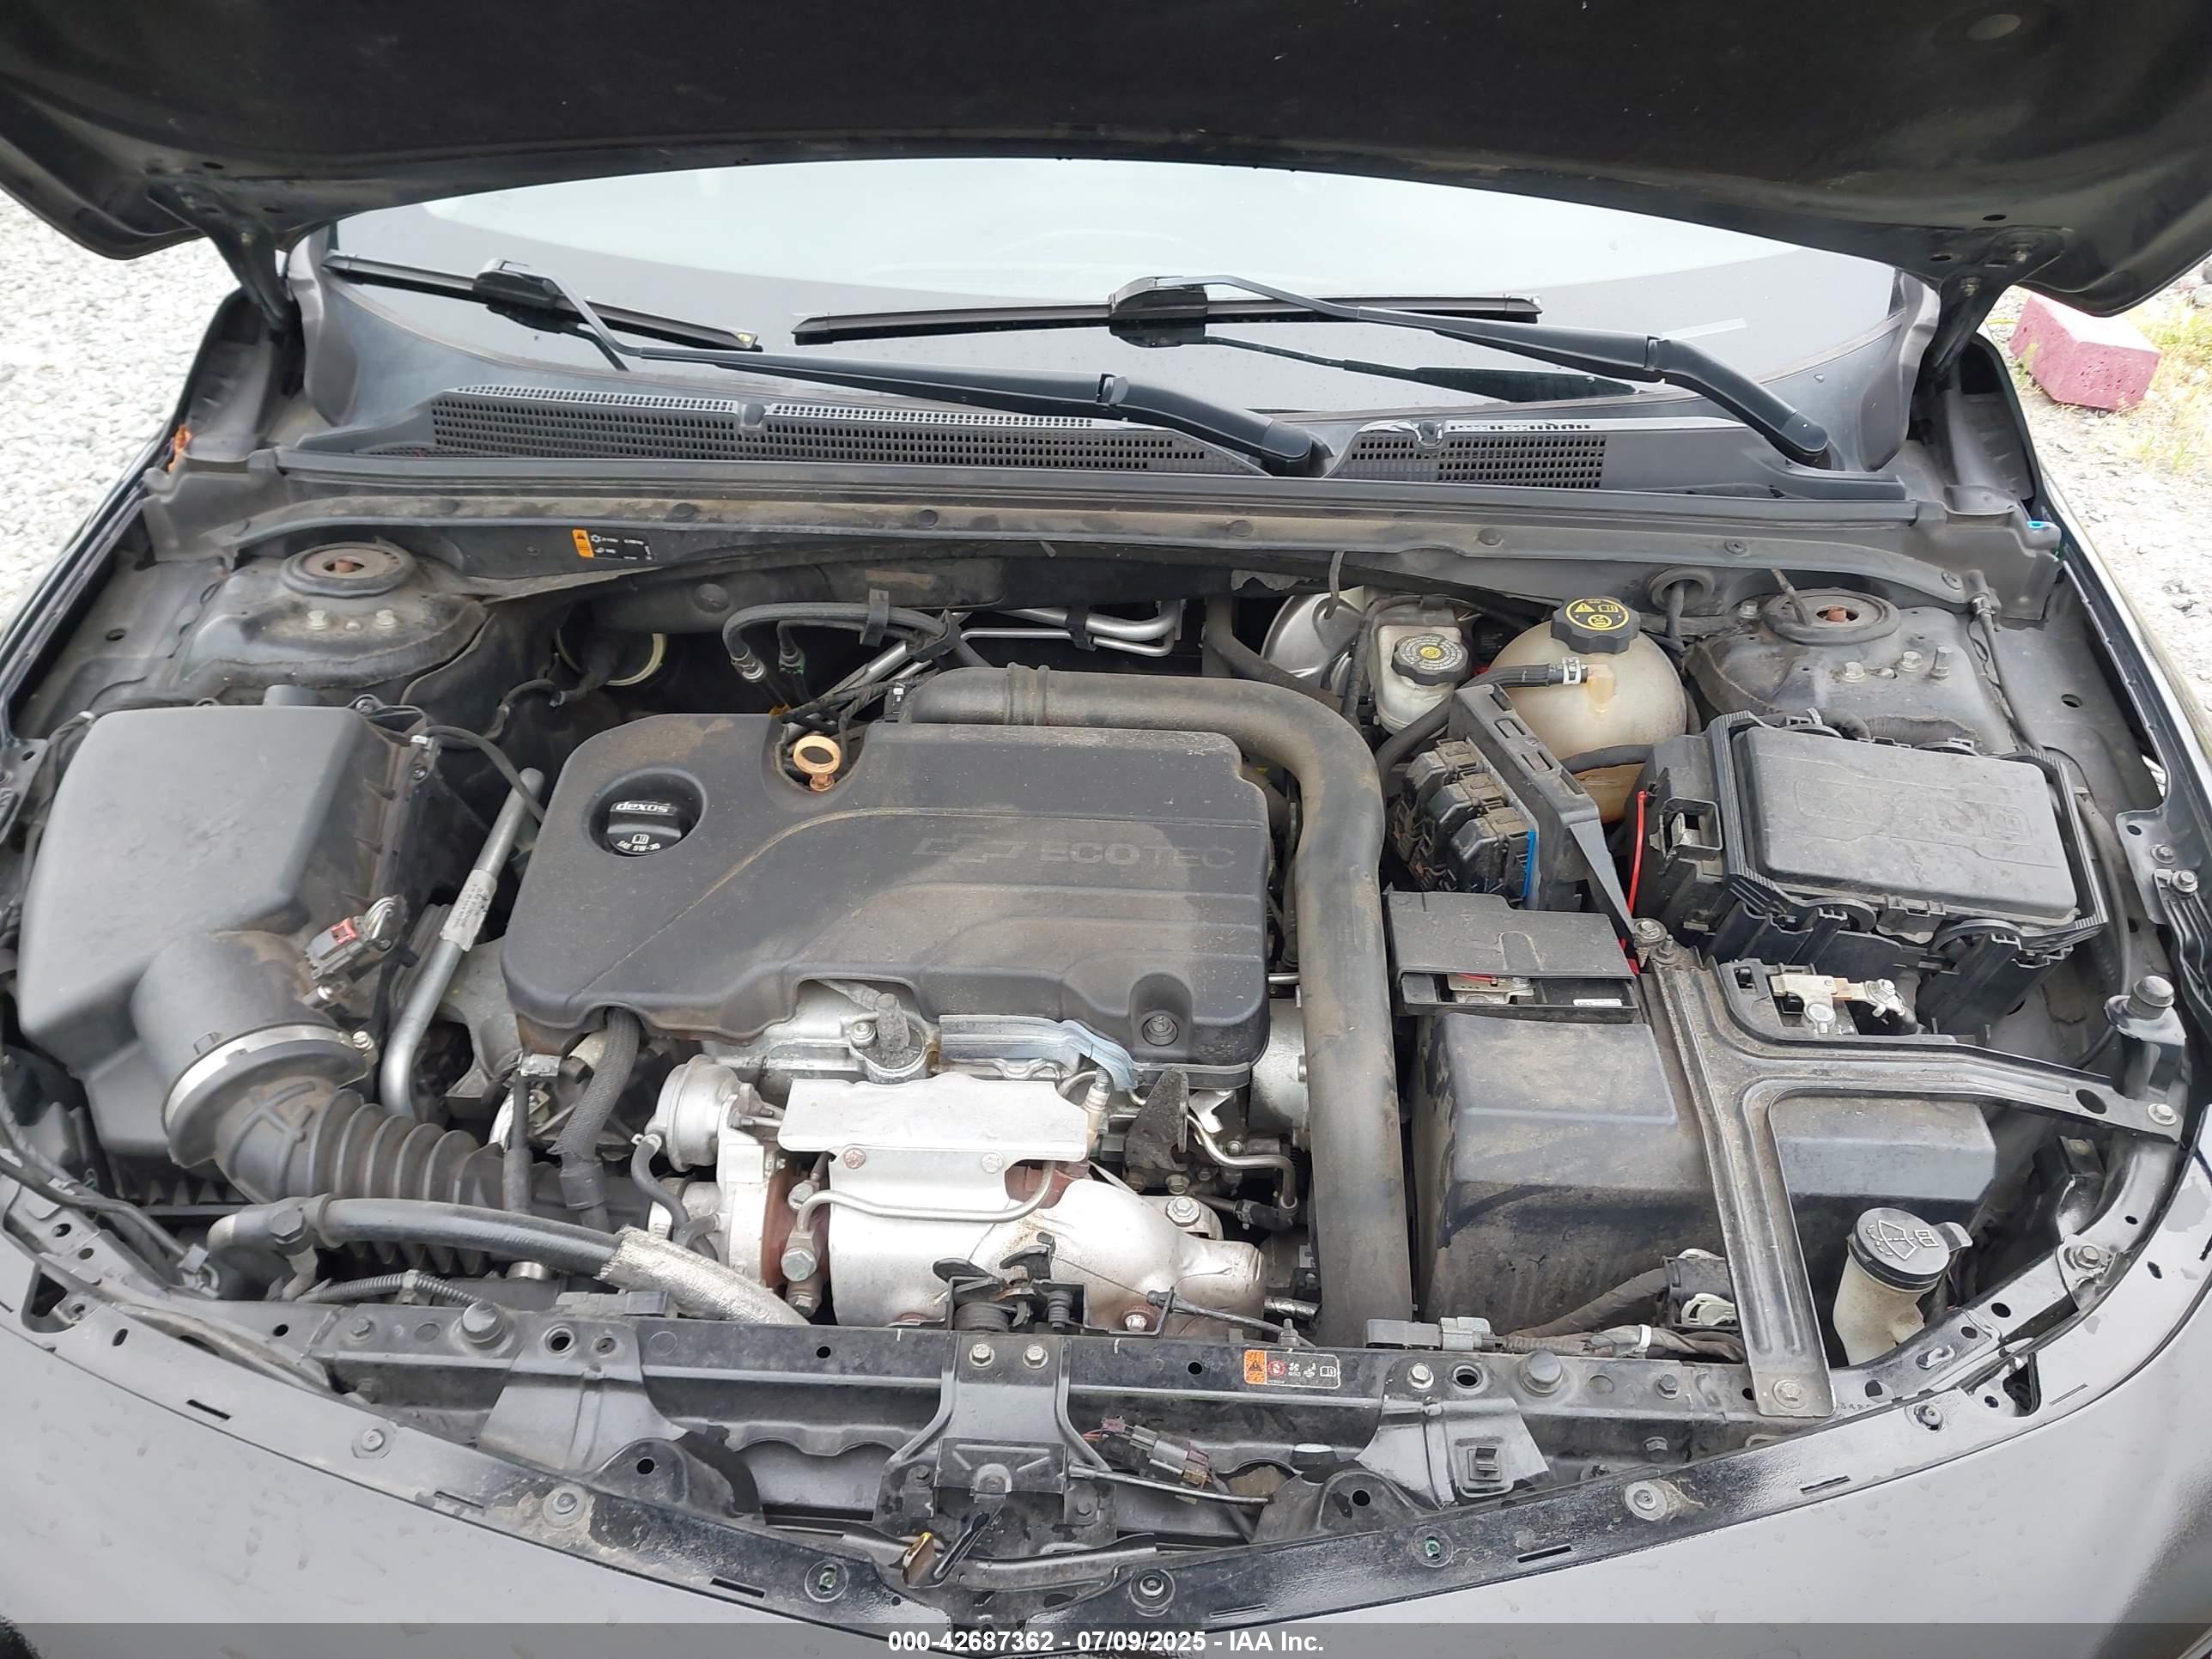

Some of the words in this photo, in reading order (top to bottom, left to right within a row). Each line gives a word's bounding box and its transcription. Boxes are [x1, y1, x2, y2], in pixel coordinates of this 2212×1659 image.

[616, 802, 670, 813] dexos
[617, 841, 632, 850] SAE
[1039, 840, 1237, 869] ECOTEC
